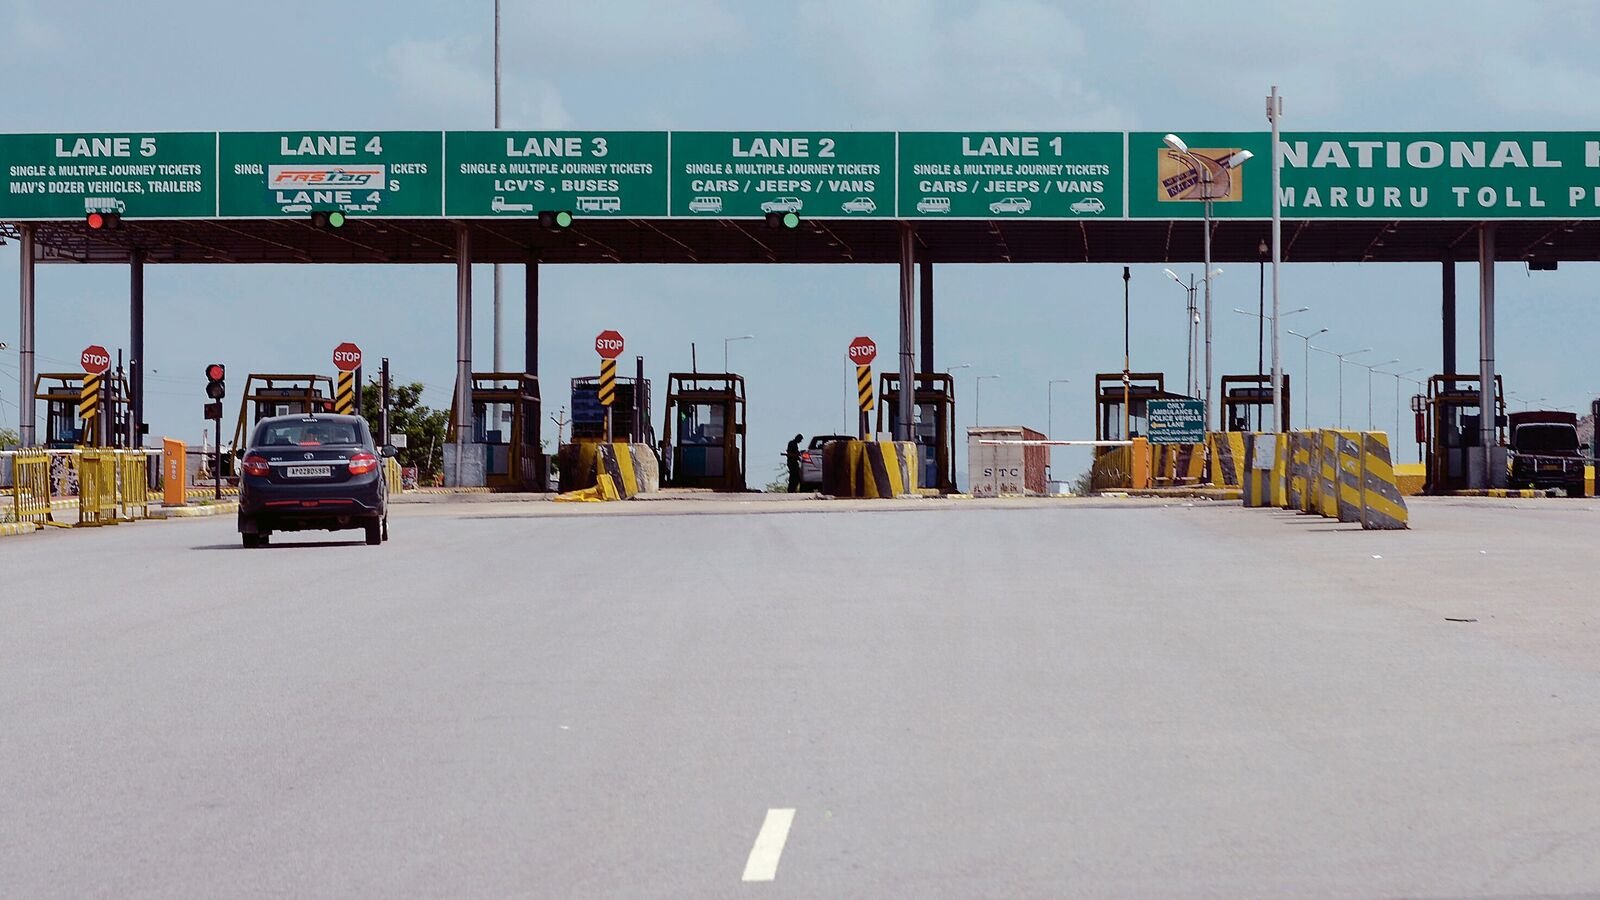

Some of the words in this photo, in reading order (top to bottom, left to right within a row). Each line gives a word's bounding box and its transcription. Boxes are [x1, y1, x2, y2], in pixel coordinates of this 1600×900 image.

[55, 137, 131, 158] LANE
[139, 137, 157, 157] 5
[280, 136, 357, 156] LANE
[364, 136, 383, 156] 4
[506, 137, 582, 157] LANE
[591, 137, 608, 157] 3
[732, 138, 809, 158] LANE
[818, 138, 835, 158] 2
[962, 137, 1040, 157] LANE
[1049, 137, 1062, 156] 1
[1279, 141, 1562, 169] NATIONAL
[10, 165, 47, 176] SINGLE
[49, 165, 57, 176] &
[59, 165, 107, 176] MULTIPLE
[109, 164, 157, 176] JOURNEY
[159, 164, 202, 176] TICKETS
[461, 163, 497, 174] SINGLE
[499, 163, 508, 174] &
[510, 163, 559, 174] MULTIPLE
[561, 163, 608, 174] JOURNEY
[610, 163, 653, 175] TICKETS
[685, 164, 723, 175] SINGLE
[725, 164, 733, 175] &
[735, 164, 785, 175] MULTIPLE
[787, 164, 835, 175] JOURNEY
[837, 164, 881, 175] TICKETS
[913, 164, 951, 175] SINGLE
[953, 164, 962, 175] &
[964, 164, 1014, 175] MULTIPLE
[1015, 164, 1064, 175] JOURNEY
[1066, 164, 1110, 176] TICKETS
[10, 181, 46, 194] MAV'S
[48, 181, 85, 194] DOZER
[87, 181, 145, 195] VEHICLES,
[147, 181, 202, 193] TRAILERS
[494, 179, 545, 192] LCV'S
[561, 179, 619, 192] BUSES
[691, 179, 739, 192] CARS
[743, 180, 751, 193] /
[755, 179, 812, 192] JEEPS
[815, 180, 824, 193] /
[828, 179, 875, 192] VANS
[919, 180, 968, 193] CARS
[971, 180, 980, 194] /
[983, 180, 1040, 193] JEEPS
[1043, 180, 1052, 194] /
[1056, 180, 1104, 193] VANS
[276, 190, 352, 204] LANE
[366, 191, 382, 204] 4
[1280, 186, 1428, 207] MARURU
[1451, 186, 1546, 207] TOLL
[597, 339, 622, 349] STOP
[850, 346, 874, 356] STOP
[82, 353, 108, 365] STOP
[335, 352, 360, 361] STOP
